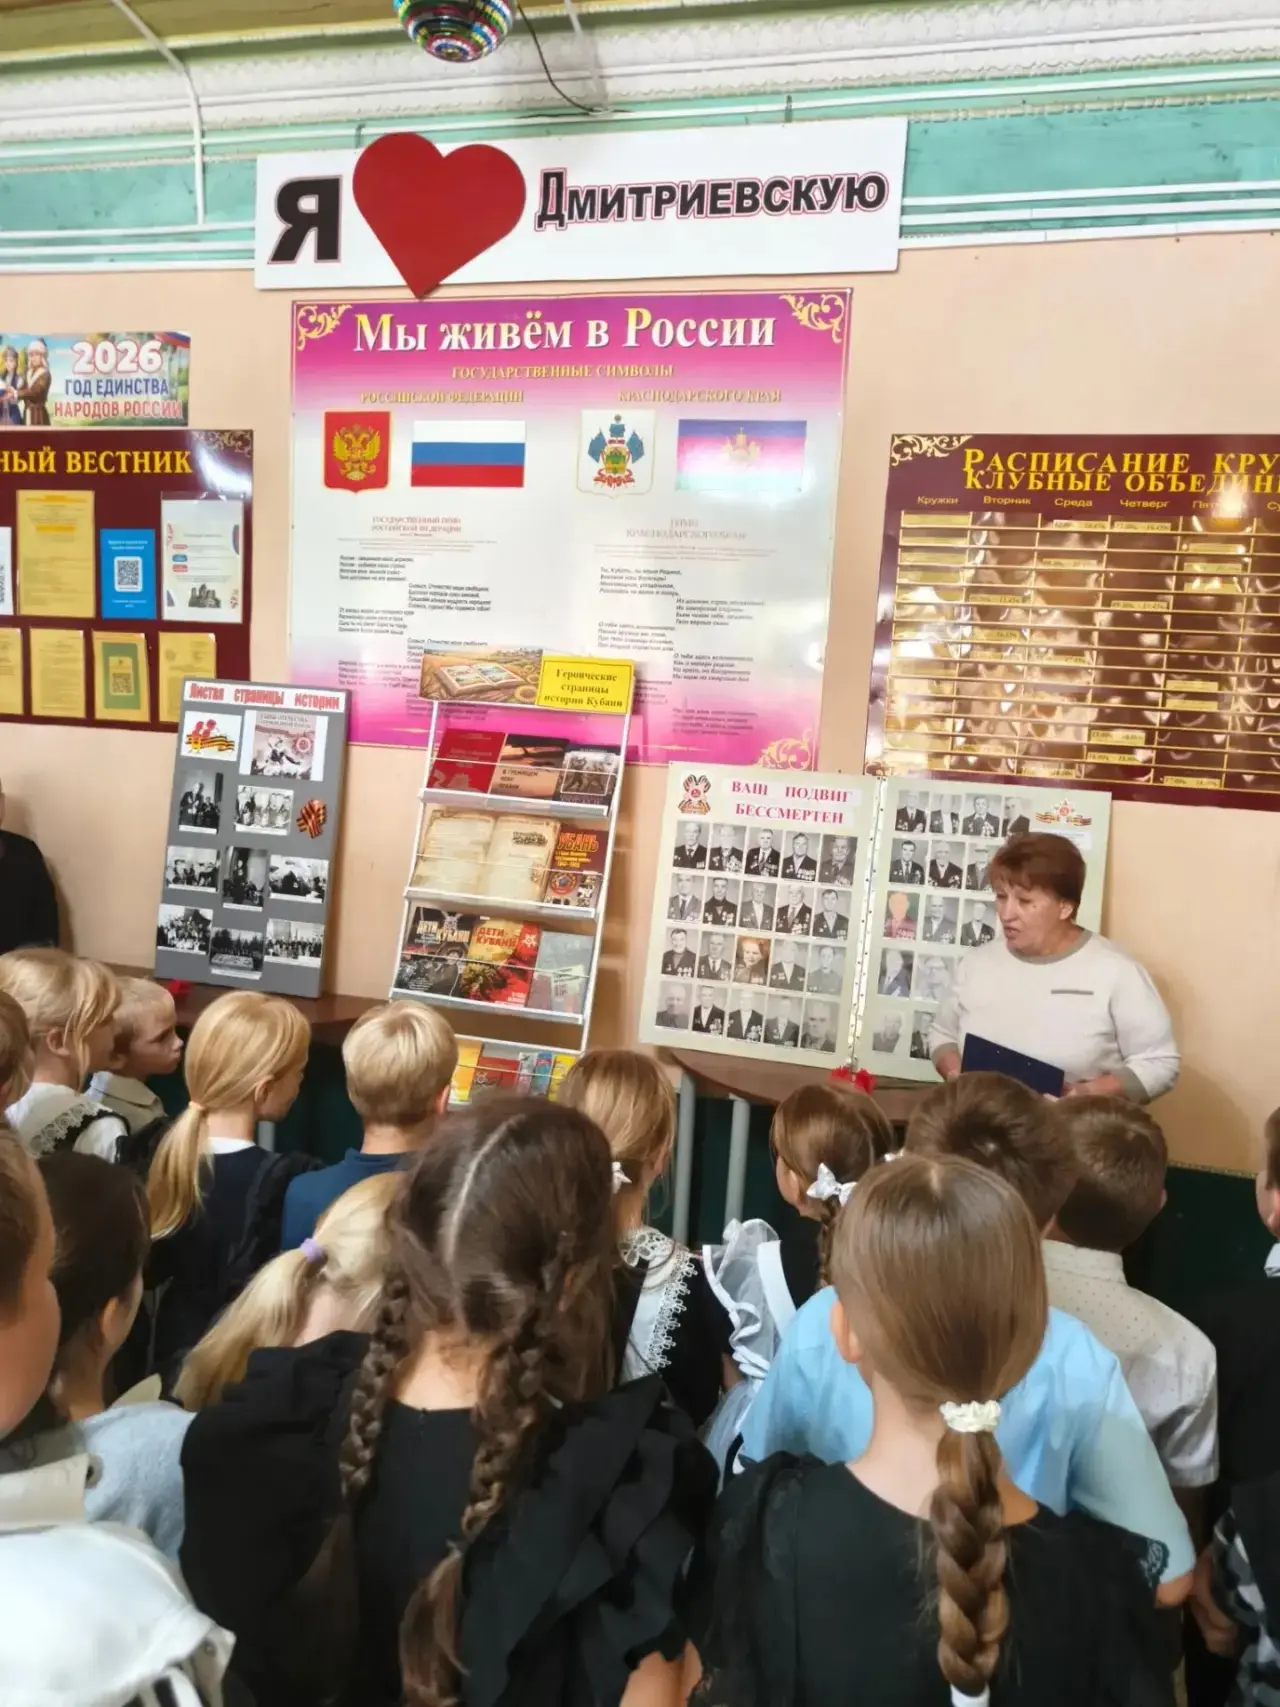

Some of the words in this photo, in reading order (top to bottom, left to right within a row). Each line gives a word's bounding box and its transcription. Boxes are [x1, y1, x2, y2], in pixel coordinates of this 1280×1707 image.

[267, 175, 342, 264] Я
[534, 168, 888, 232] ДМИТРИЕВСКУЮ
[355, 313, 428, 351] Мы
[439, 310, 574, 351] живём
[587, 319, 609, 348] в
[623, 307, 775, 348] России
[71, 340, 163, 375] 2026
[451, 366, 591, 380] ГОСУДАРСТВЕННЫЕ
[595, 364, 675, 378] СИМВОЛЫ
[65, 379, 92, 398] ГОД
[96, 379, 169, 398] ЕДИНСТВА
[619, 389, 744, 403] КРАСНОДАРСКОГО
[54, 401, 119, 419] НАРОДОВ
[124, 400, 182, 418] РОССИИ
[66, 450, 193, 474] ВЕСТНИК
[963, 448, 1190, 474] РАСПИСАНИЕ
[965, 470, 1111, 491] КЛУБНЫЕ
[1125, 473, 1280, 496] ОБЪЕДИН
[917, 495, 959, 506] Кружки
[983, 495, 1031, 506] Вторник
[1054, 498, 1093, 508] Среда
[1120, 498, 1171, 509] Четверг
[556, 668, 618, 682] Героические
[561, 683, 609, 695] страницы
[234, 688, 284, 706] страницы
[295, 692, 340, 711] истории
[544, 695, 583, 706] истории
[587, 696, 623, 708] Кубани
[732, 780, 768, 796] ВАШ
[785, 785, 853, 803] ПОДВИГ
[735, 803, 844, 824] БЕССМЕРТЕН
[477, 927, 505, 938] ДЕТИ
[475, 936, 519, 949] КУБАНИ
